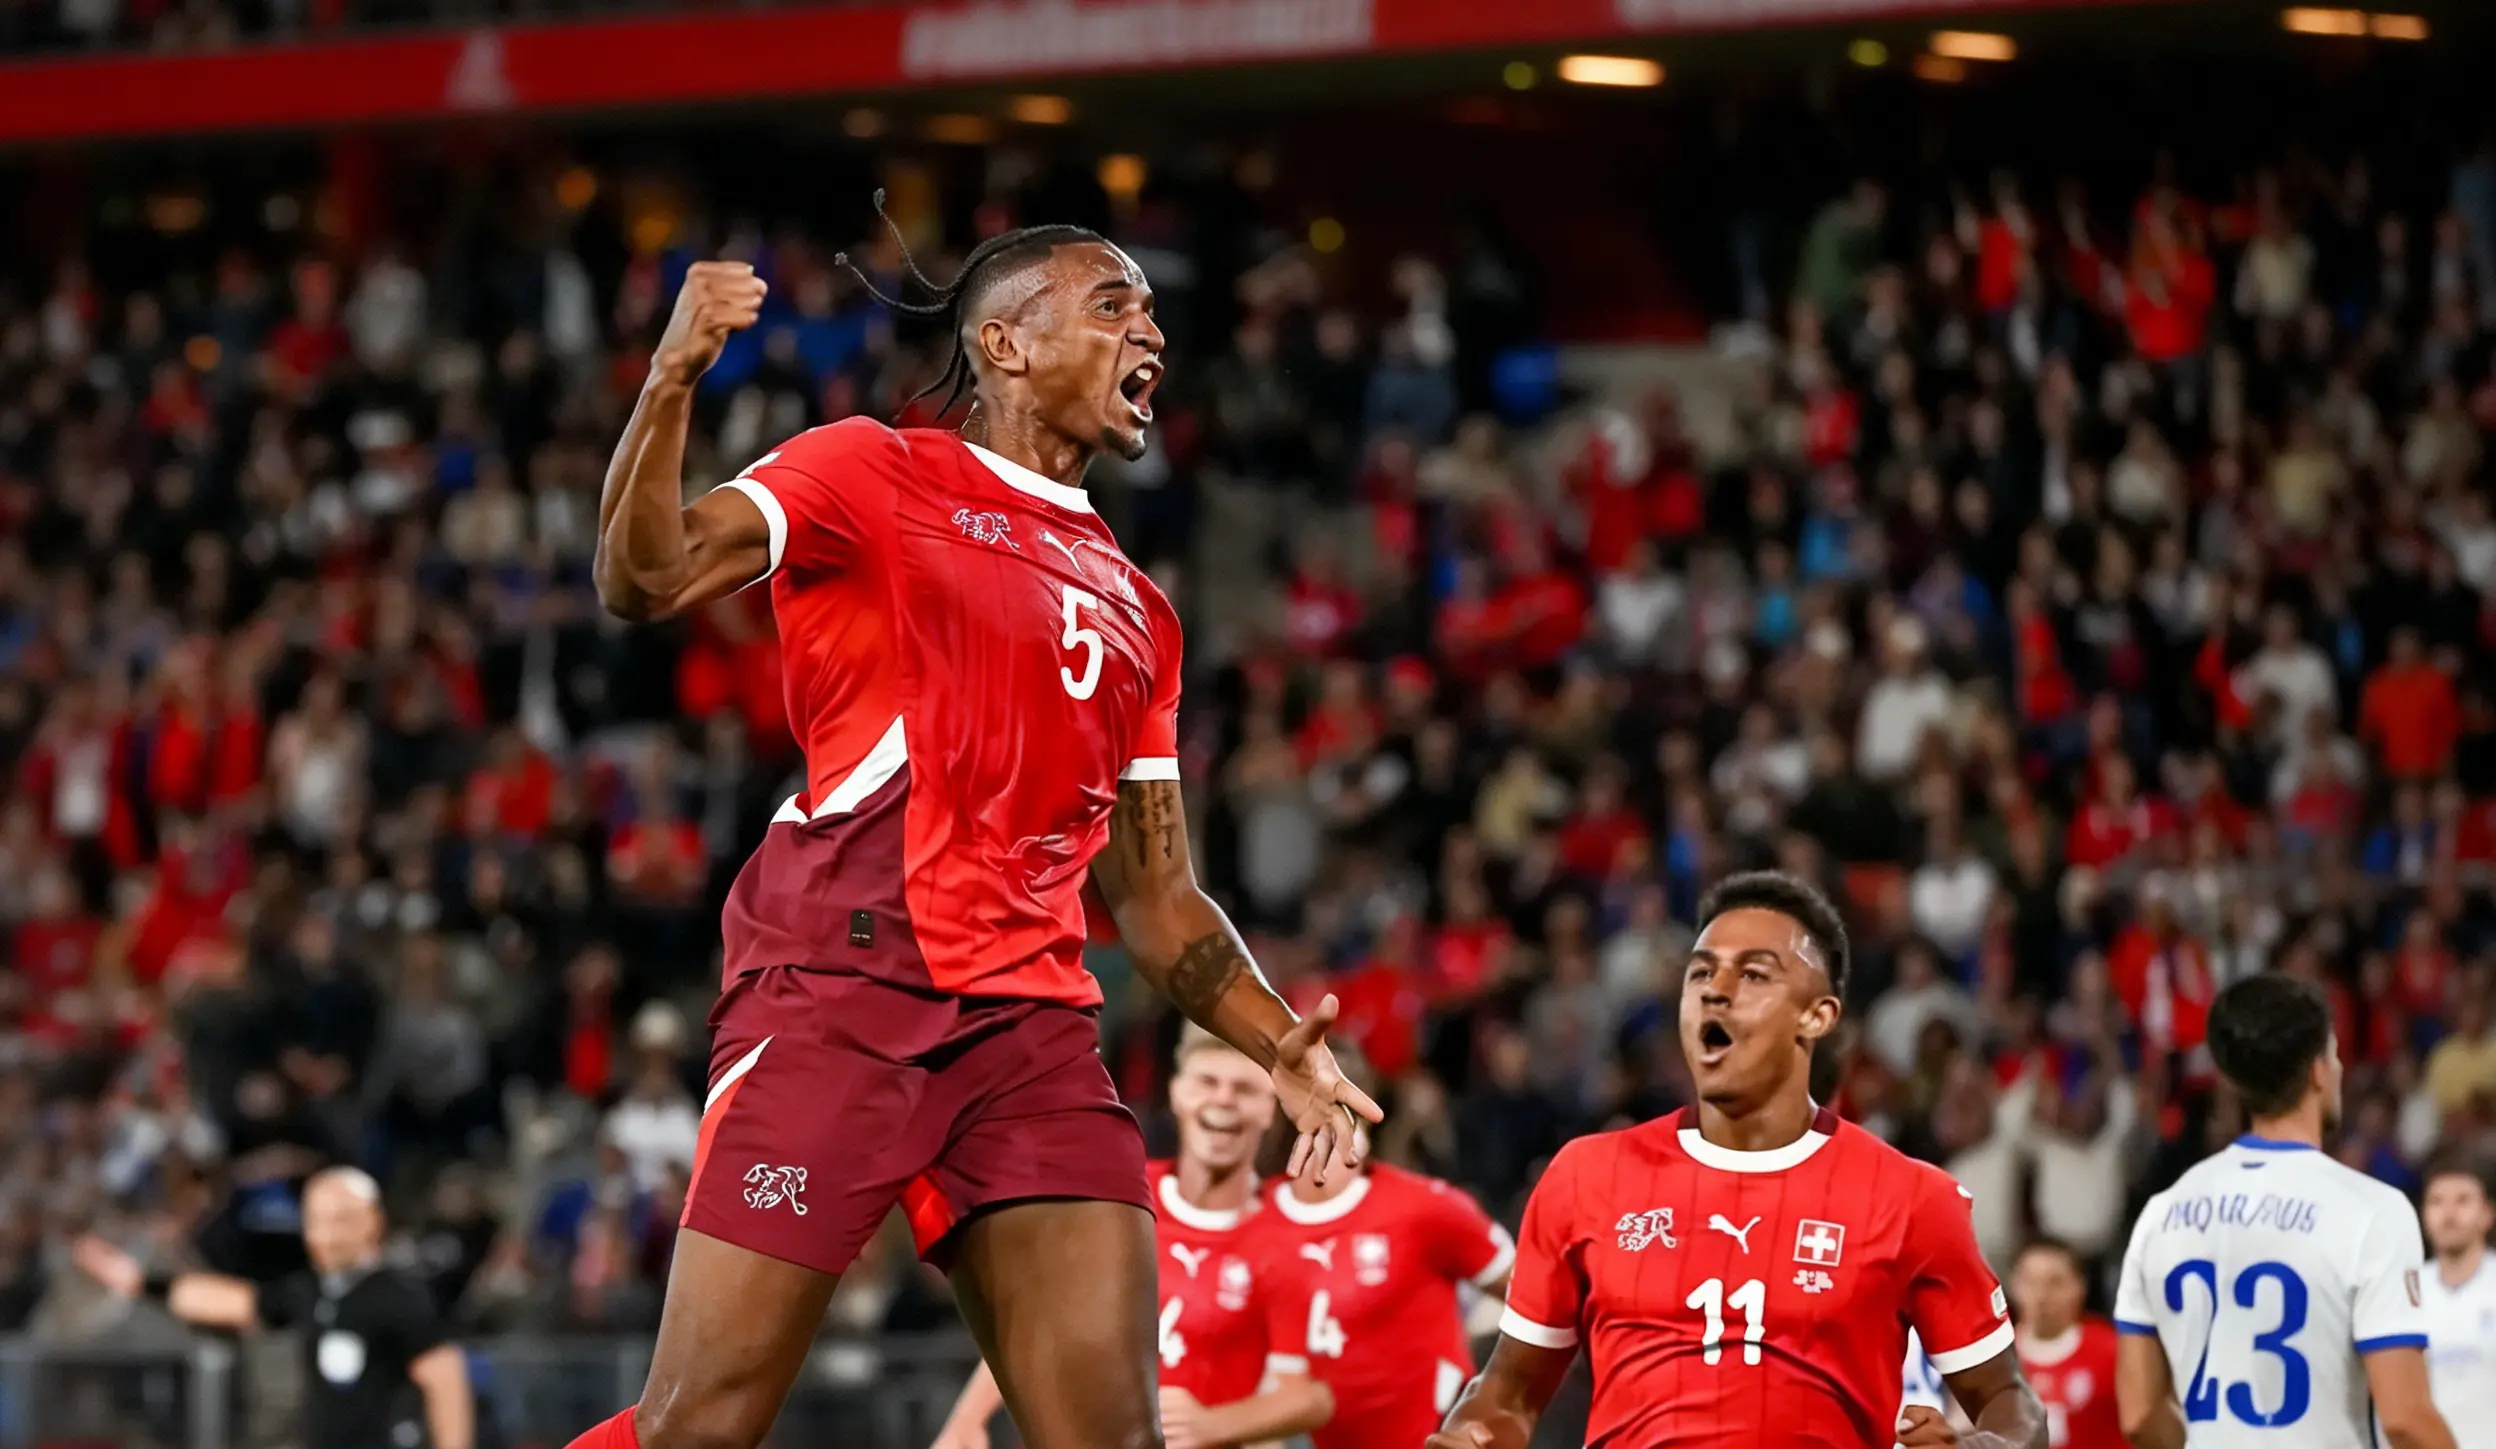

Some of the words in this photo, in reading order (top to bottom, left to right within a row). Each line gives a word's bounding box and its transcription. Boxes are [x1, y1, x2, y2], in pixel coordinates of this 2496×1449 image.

[1060, 584, 1104, 700] 5
[1306, 1289, 1349, 1358] 4
[1685, 1277, 1766, 1366] 11
[2164, 1259, 2310, 1428] 23
